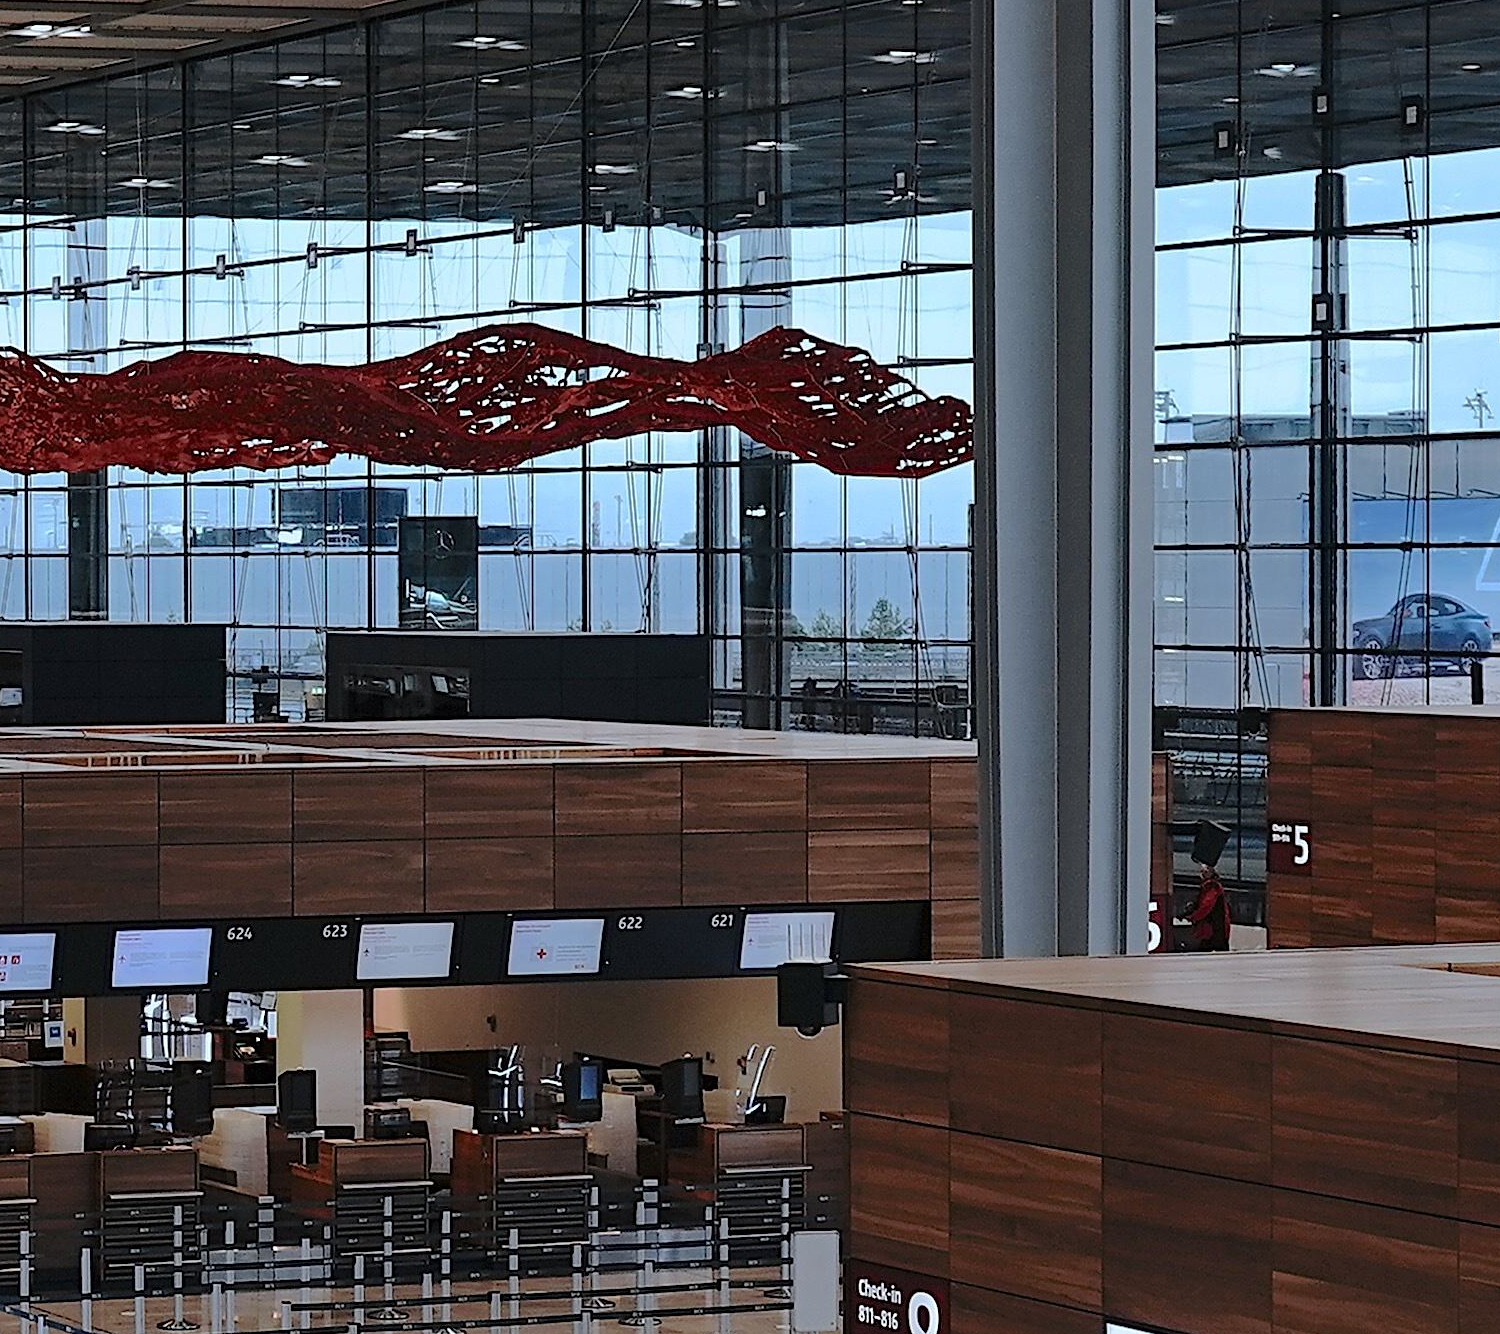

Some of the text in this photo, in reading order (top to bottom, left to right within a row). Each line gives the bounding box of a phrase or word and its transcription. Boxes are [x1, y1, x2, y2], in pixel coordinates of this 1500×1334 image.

[1293, 825, 1309, 865] 5
[618, 916, 644, 930] 622
[711, 914, 734, 928] 621
[226, 927, 253, 941] 624
[322, 923, 348, 938] 623
[858, 1278, 901, 1305] Check-in
